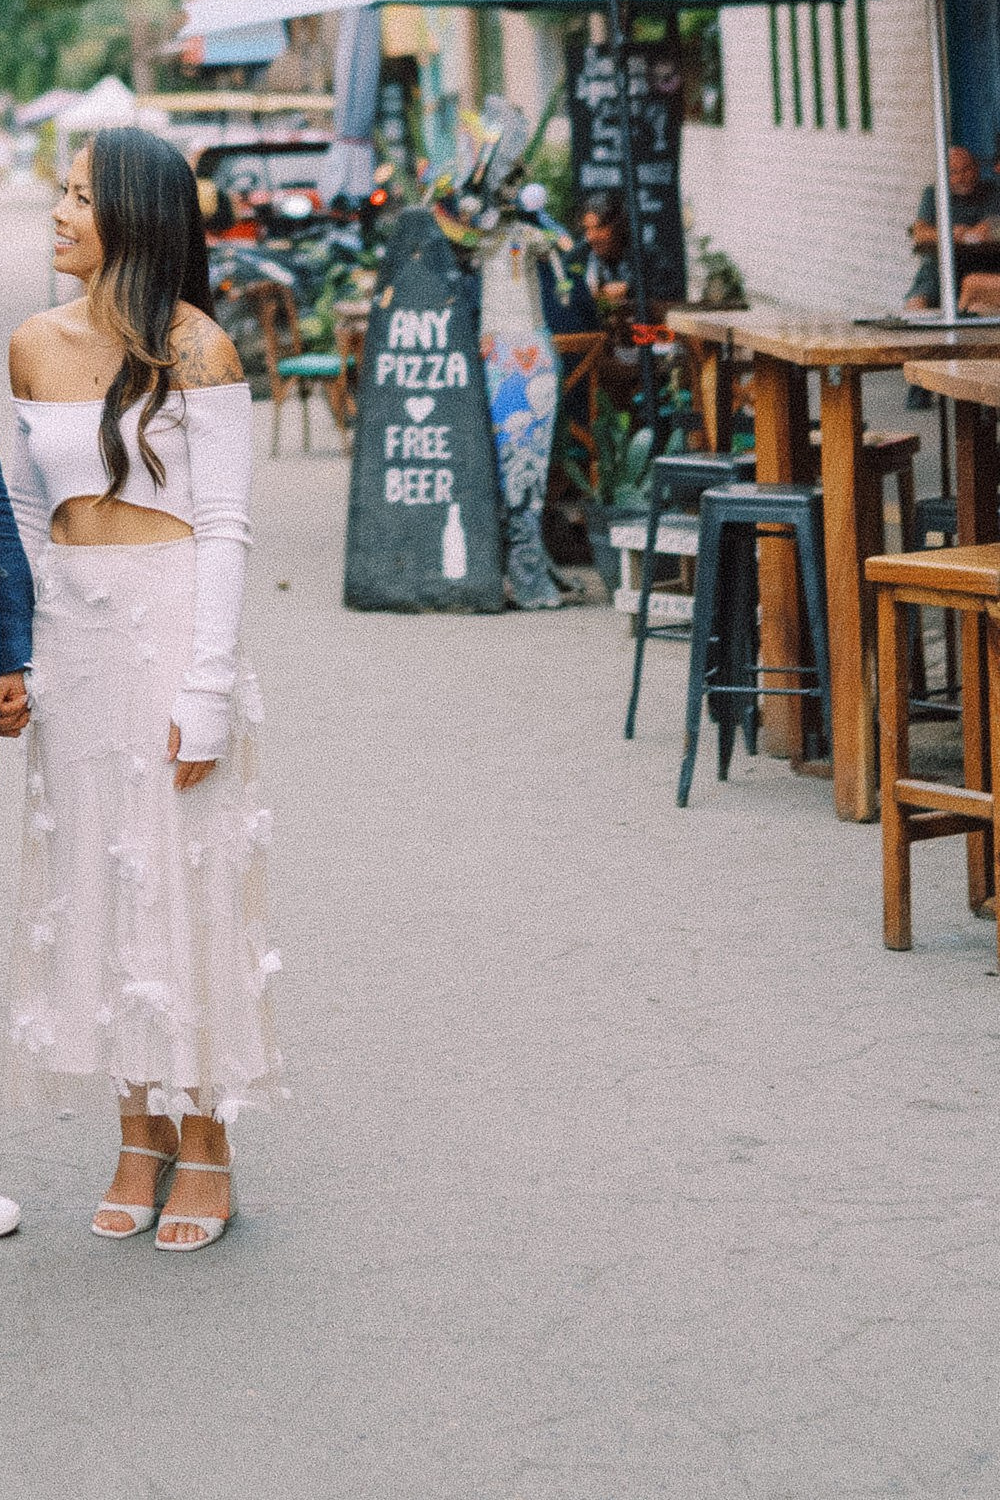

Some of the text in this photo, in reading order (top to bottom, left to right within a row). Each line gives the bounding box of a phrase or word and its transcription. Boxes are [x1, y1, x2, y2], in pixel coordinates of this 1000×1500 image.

[388, 308, 451, 349] ANY
[376, 351, 469, 390] PIZZA
[385, 424, 452, 461] FREE
[385, 467, 454, 506] BEER
